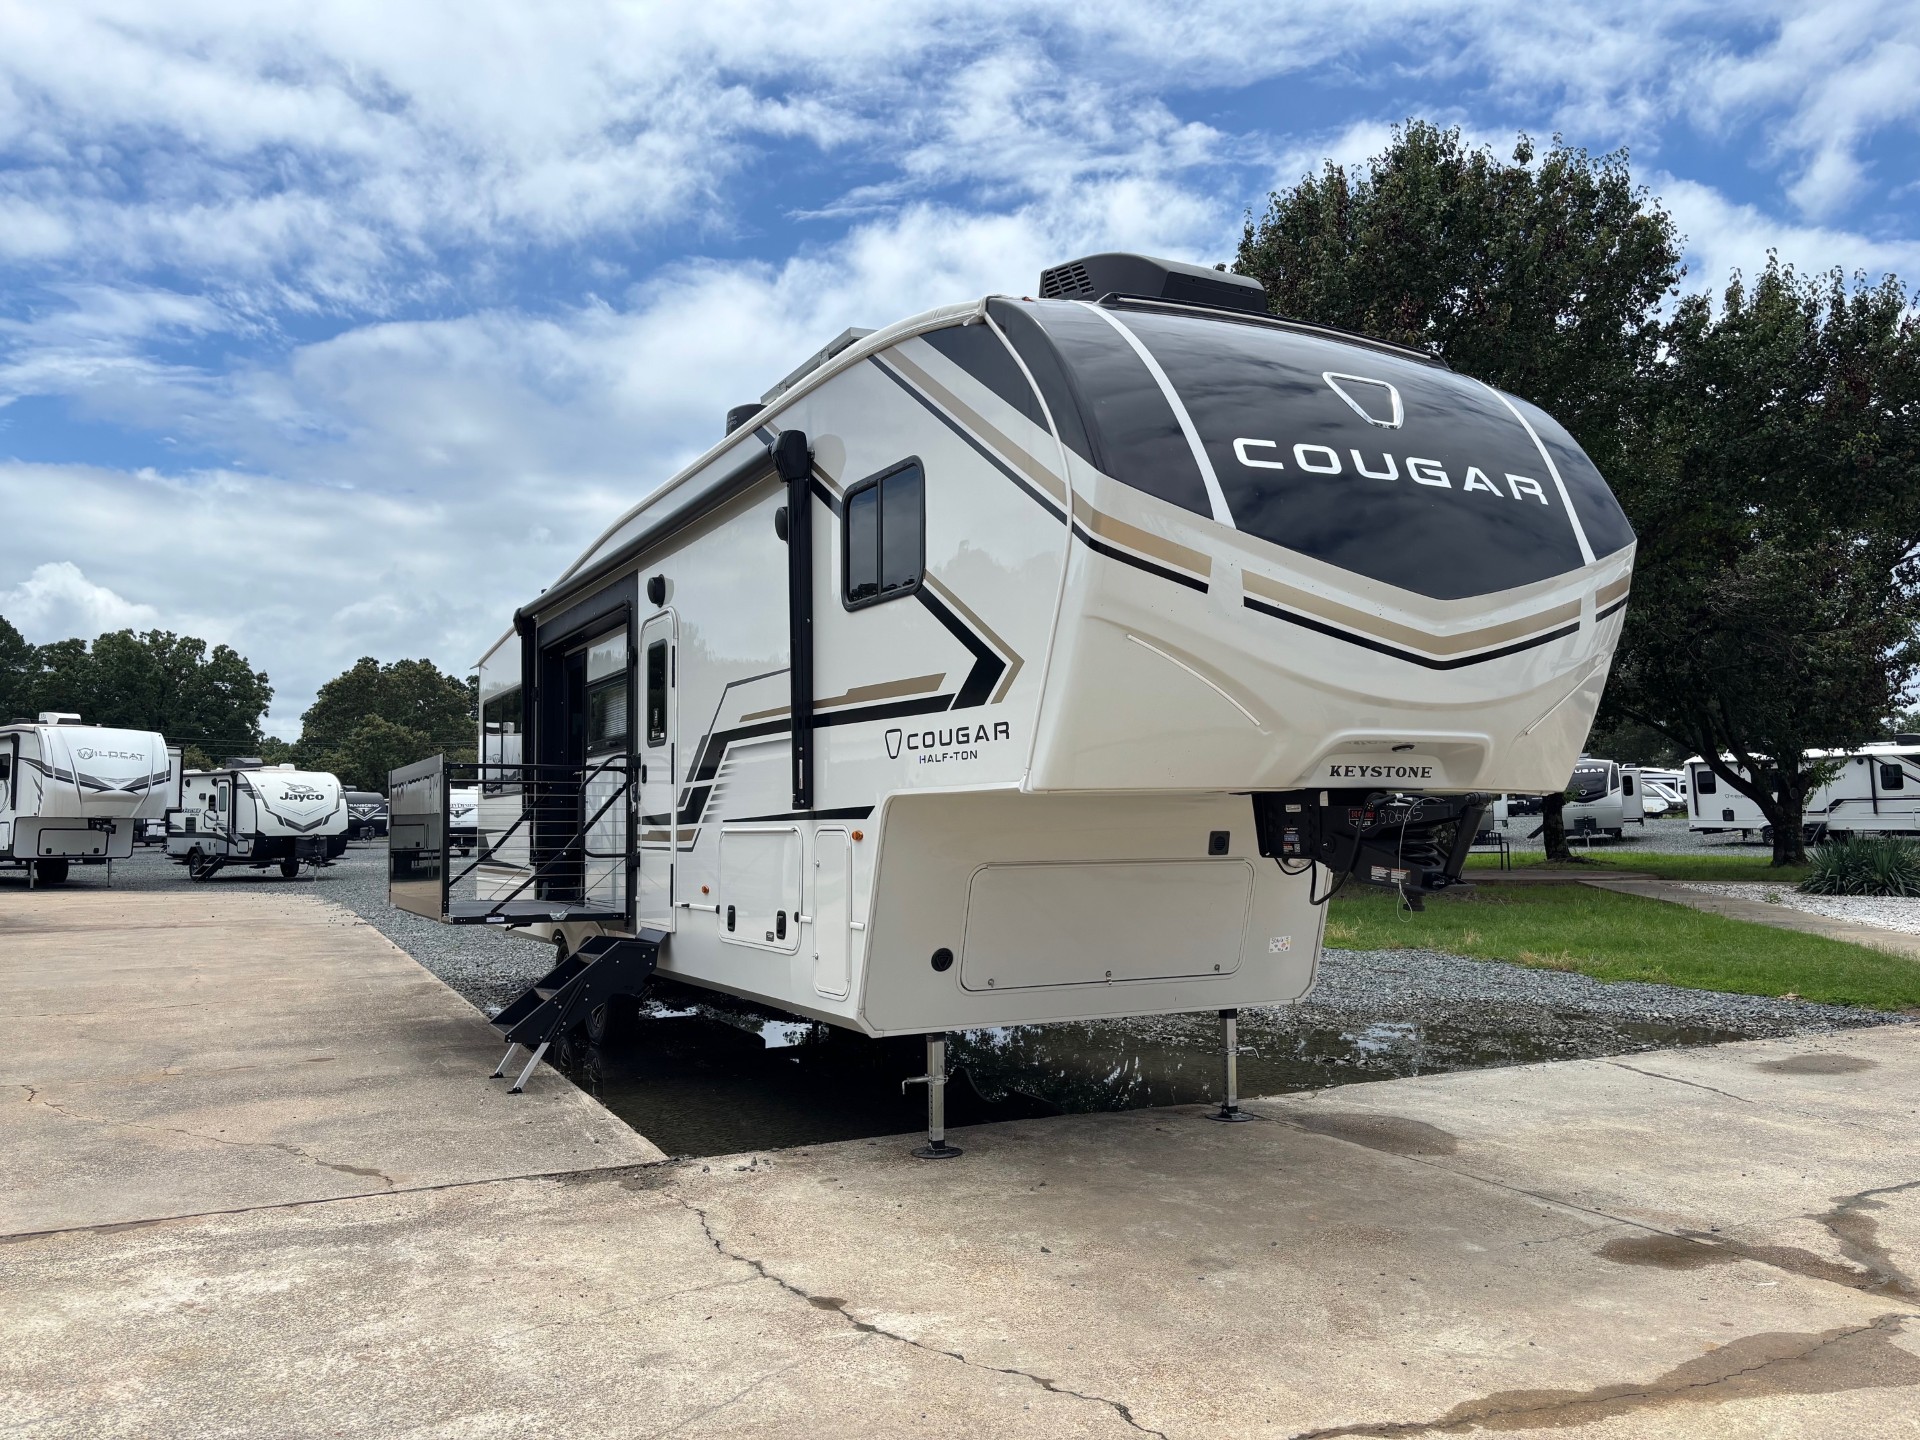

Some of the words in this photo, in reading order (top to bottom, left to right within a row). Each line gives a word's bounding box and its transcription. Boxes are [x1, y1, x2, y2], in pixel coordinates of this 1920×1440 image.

[1232, 437, 1549, 505] COUGAR
[907, 721, 1010, 750] COUGAR
[77, 747, 145, 761] WILDCAT
[919, 750, 978, 764] HALF-TON
[1329, 765, 1433, 778] KEYSTONE
[279, 791, 325, 803] Jayco
